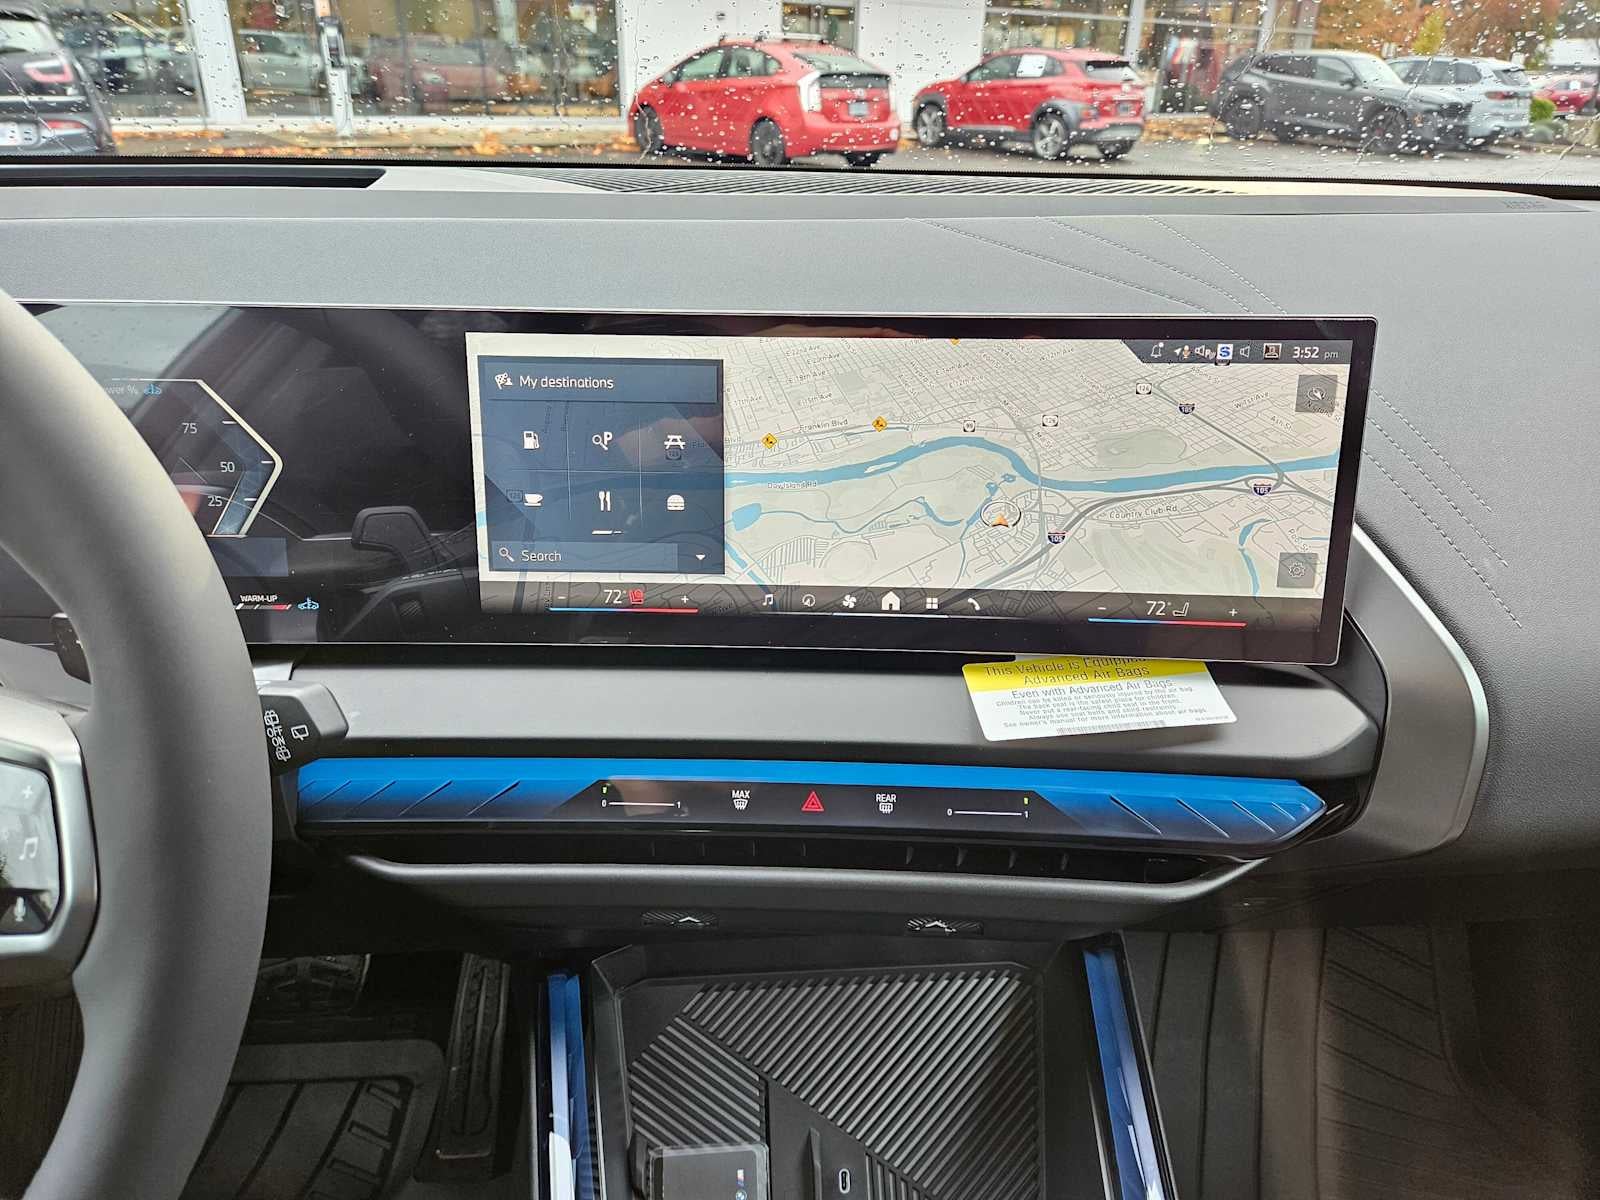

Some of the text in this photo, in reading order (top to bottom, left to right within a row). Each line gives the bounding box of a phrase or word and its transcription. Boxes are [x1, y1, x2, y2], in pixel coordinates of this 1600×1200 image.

[1292, 346, 1339, 360] 3:52 pm
[519, 375, 615, 389] My destinations
[182, 422, 197, 434] 75
[220, 461, 235, 473] 50
[1256, 486, 1269, 495] 105
[207, 495, 223, 507] 25
[1109, 510, 1143, 520] Country
[1163, 504, 1178, 513] Rd
[521, 549, 562, 562] Search
[239, 594, 278, 602] WARM-UP
[985, 666, 1013, 676] This
[1015, 660, 1064, 674] Vehicle
[1068, 659, 1080, 670] is
[1024, 666, 1150, 685] Advanced Air Bags
[1012, 689, 1040, 699] Even
[1041, 686, 1065, 697] with
[1069, 681, 1123, 695] Advanced
[1126, 681, 1141, 690] Air
[266, 725, 283, 738] OFF
[272, 735, 286, 748] ON
[731, 789, 751, 799] MAX
[875, 793, 897, 803] REAR
